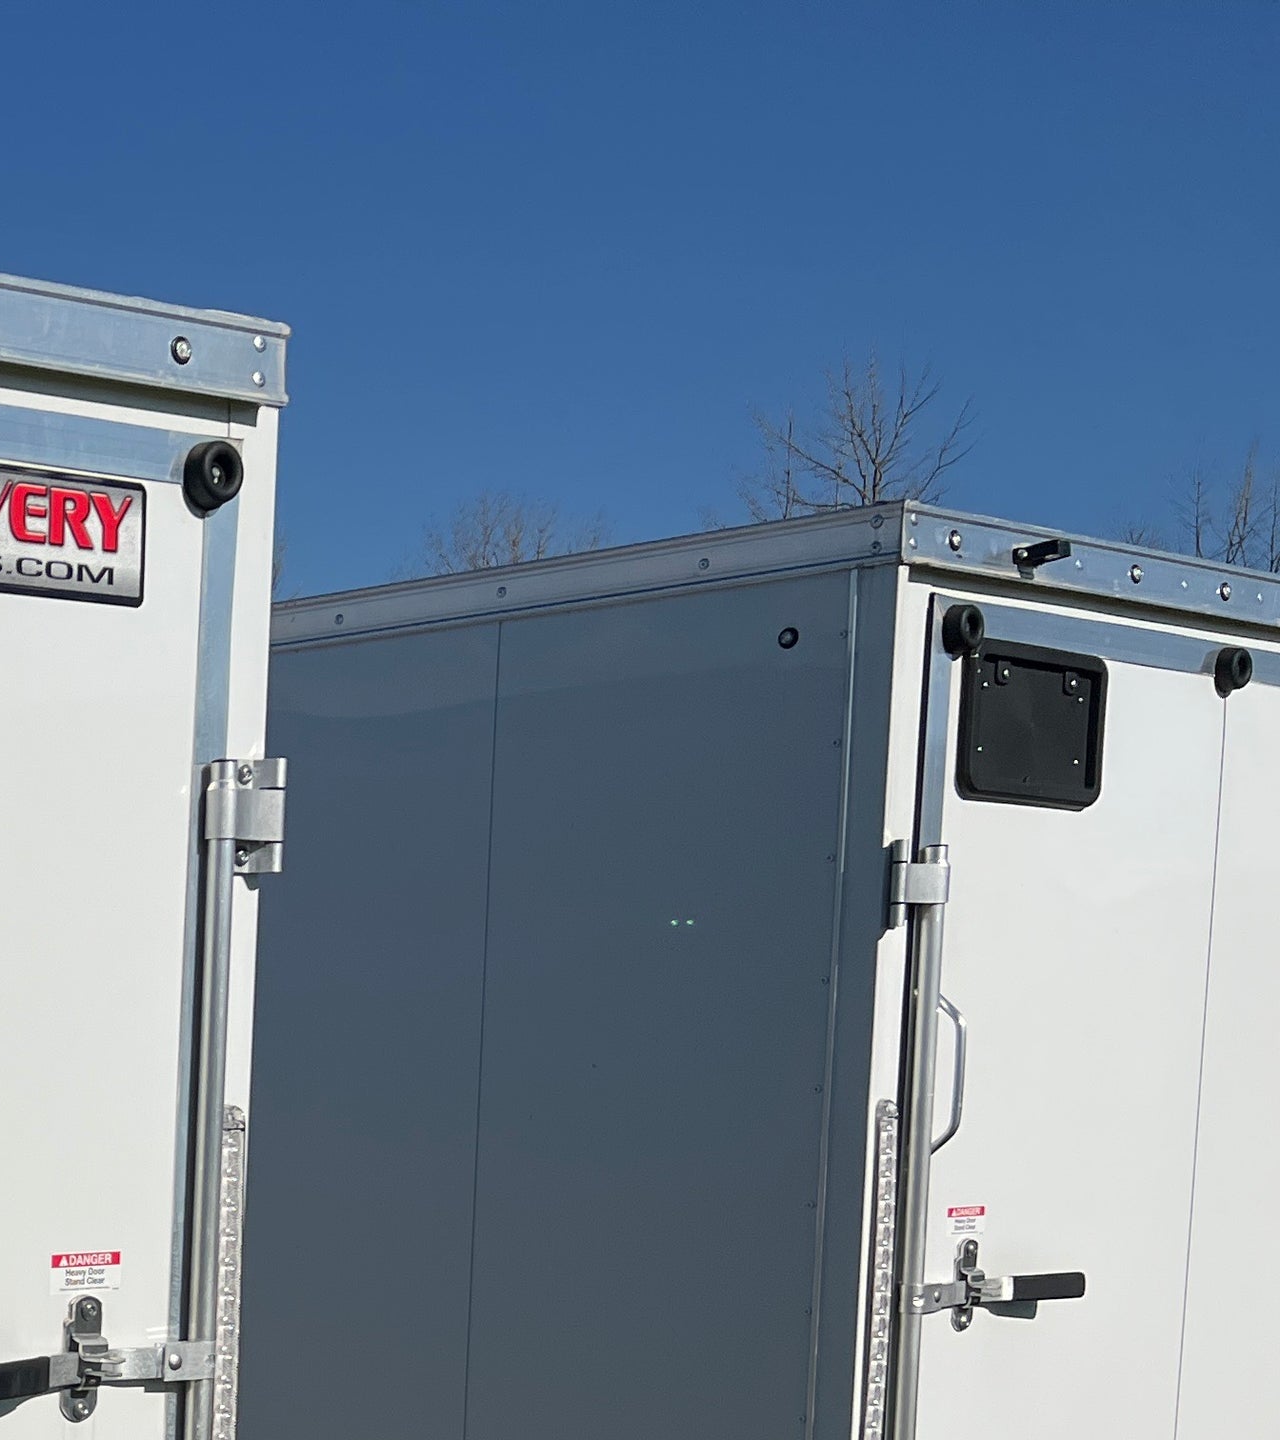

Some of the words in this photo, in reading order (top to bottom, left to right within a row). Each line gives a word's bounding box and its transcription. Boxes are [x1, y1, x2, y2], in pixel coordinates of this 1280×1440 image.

[69, 1254, 112, 1265] DANGER
[65, 1269, 86, 1277] Heavy
[65, 1278, 85, 1286] Stand
